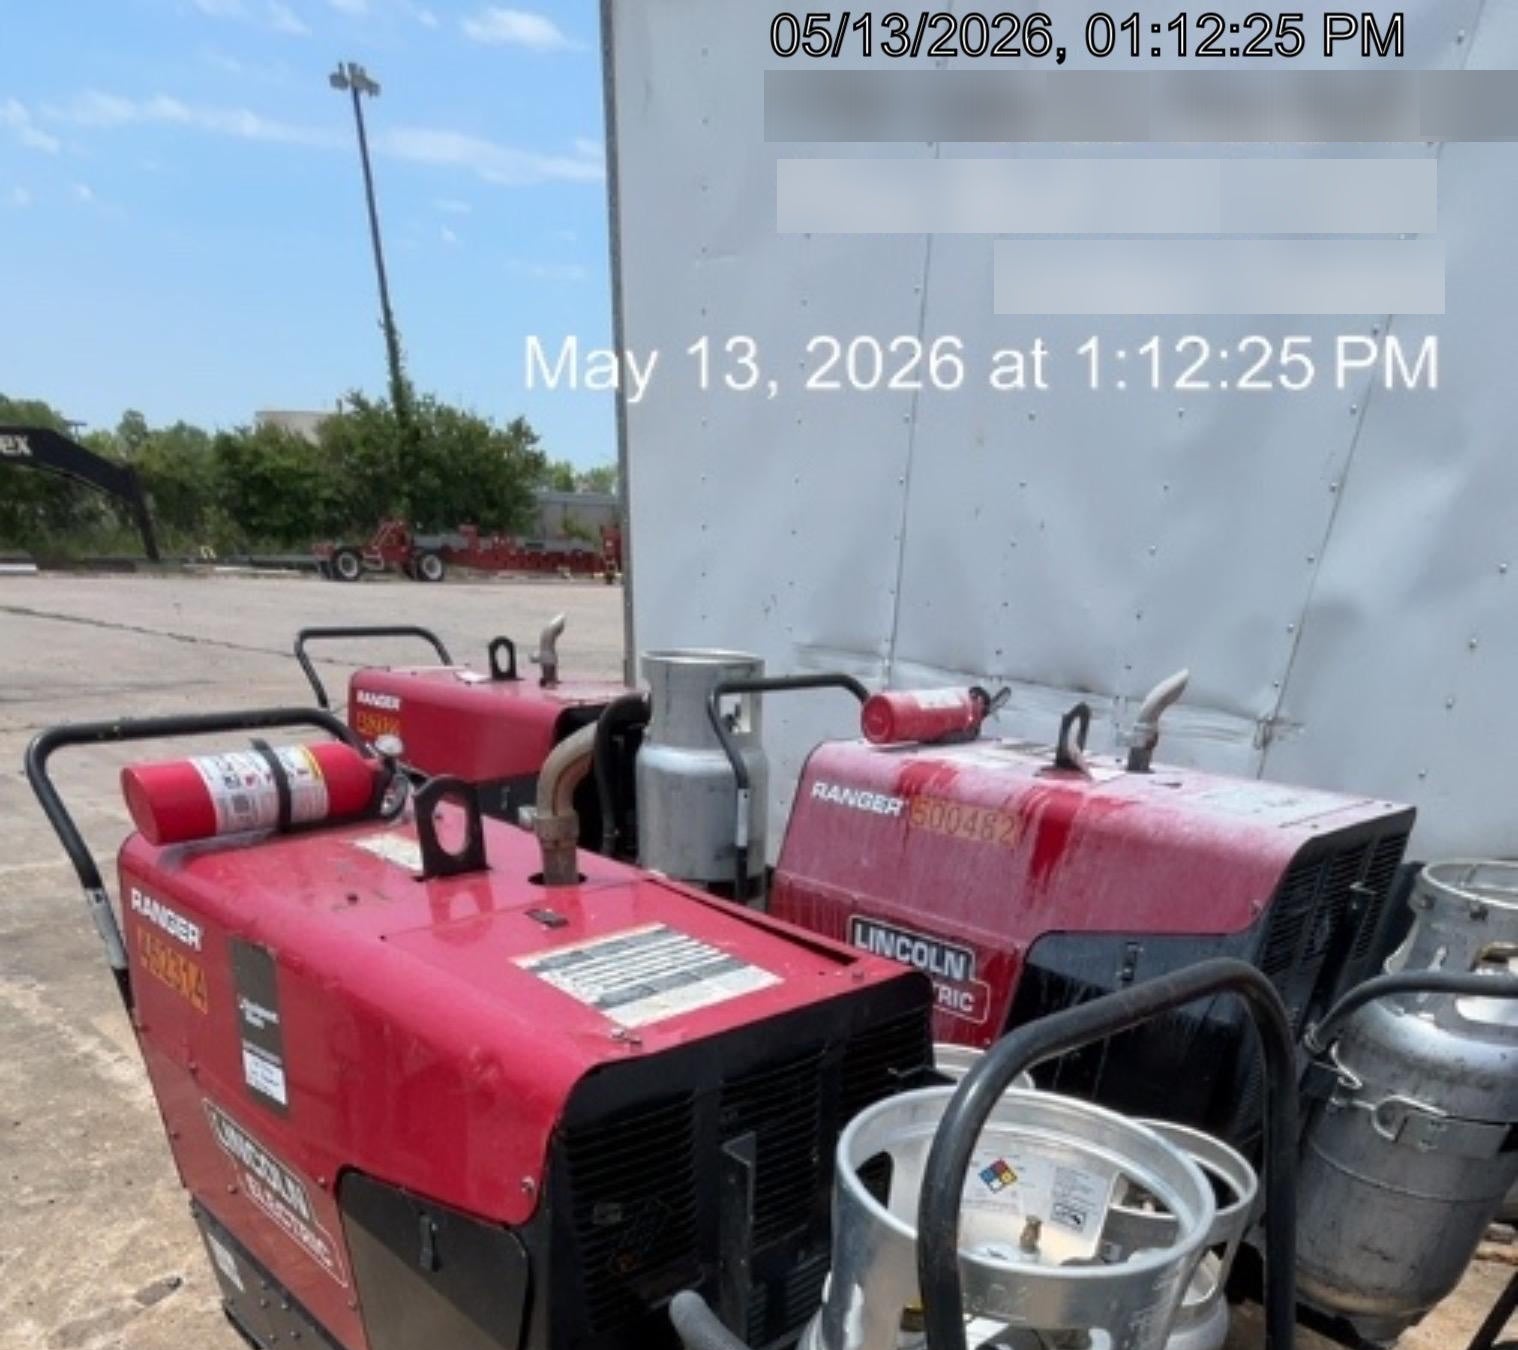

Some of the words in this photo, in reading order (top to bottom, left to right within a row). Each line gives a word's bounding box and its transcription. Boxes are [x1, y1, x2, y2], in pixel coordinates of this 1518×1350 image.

[811, 780, 904, 816] RANGER
[130, 886, 203, 952] RANGER
[853, 922, 966, 981] LINCOLN
[209, 1112, 311, 1222] LINCOLN
[243, 1171, 333, 1268] ELECTRIC
